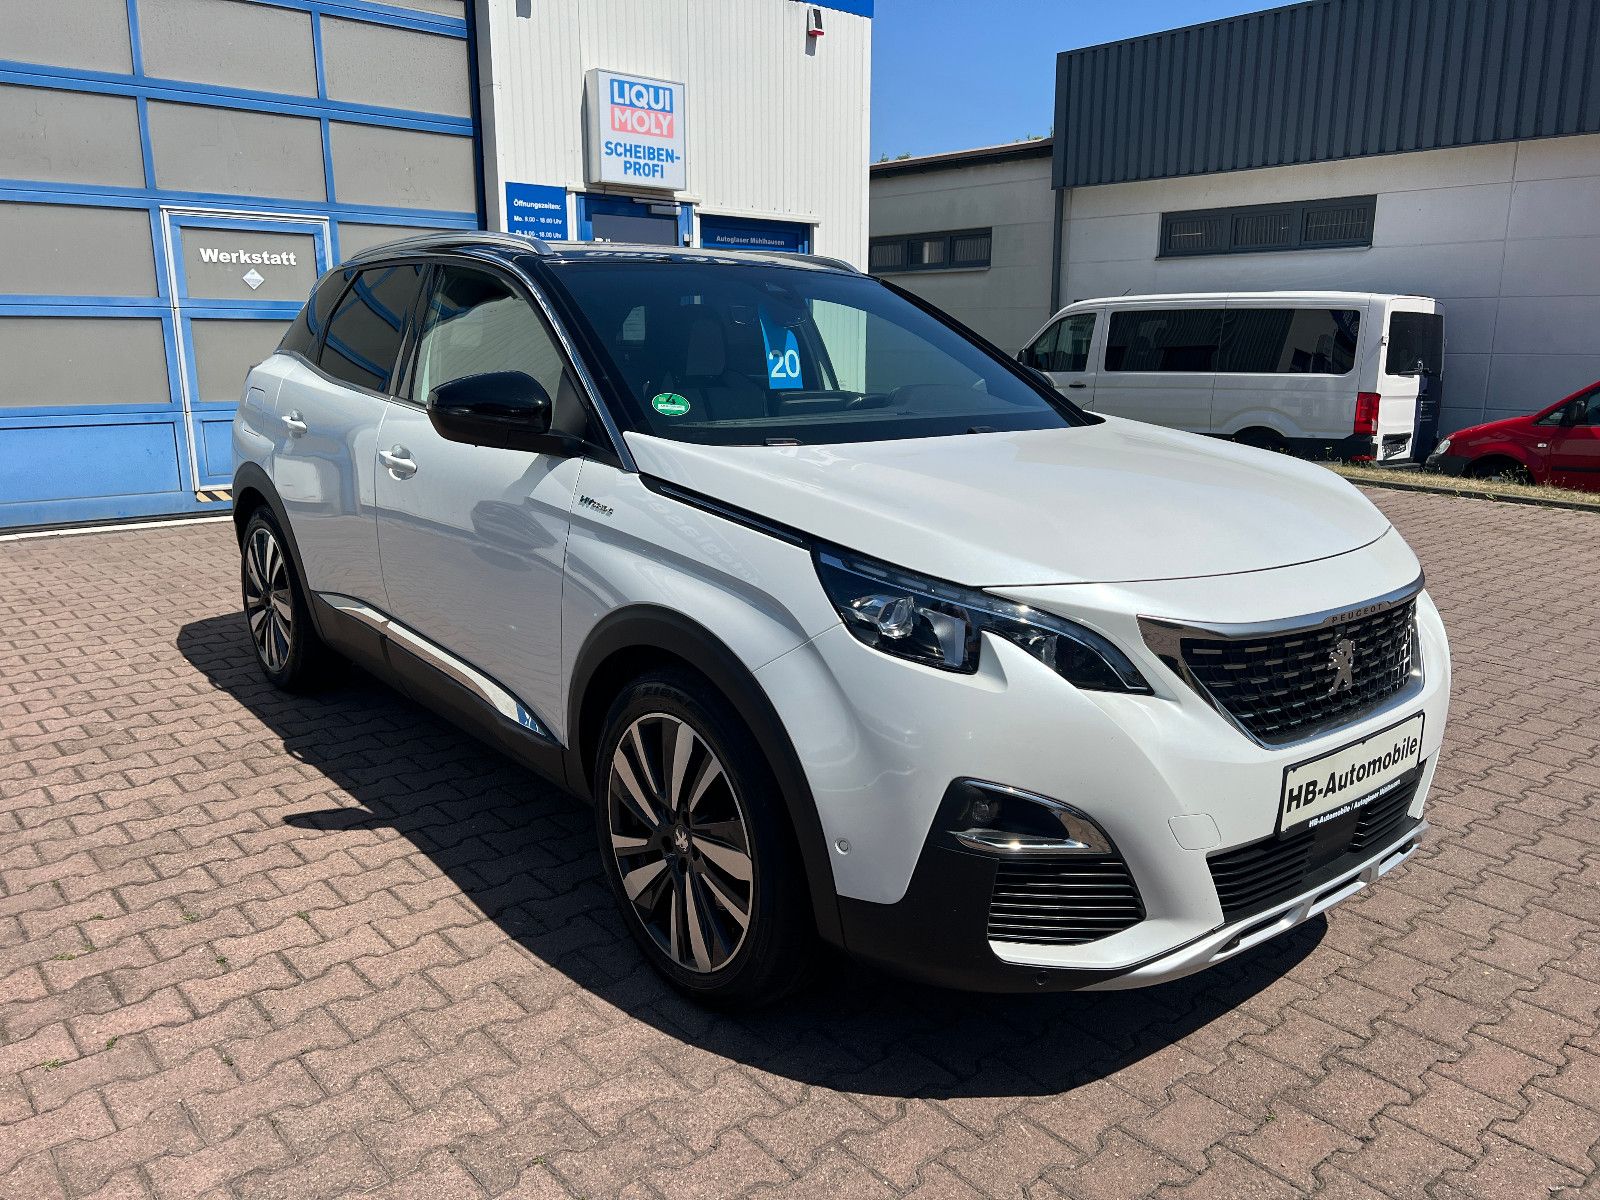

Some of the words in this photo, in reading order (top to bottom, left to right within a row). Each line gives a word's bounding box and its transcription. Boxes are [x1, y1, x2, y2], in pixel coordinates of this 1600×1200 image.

[613, 81, 671, 111] LIQUI
[613, 107, 672, 136] MOLY
[604, 140, 681, 163] SCHEIBEN-
[623, 160, 664, 178] PROFI
[716, 235, 749, 244] Autoglaser
[199, 247, 297, 266] Werkstatt
[768, 349, 800, 378] 20
[1332, 603, 1383, 623] PEUGEOT
[1286, 736, 1418, 814] HB-Automobile
